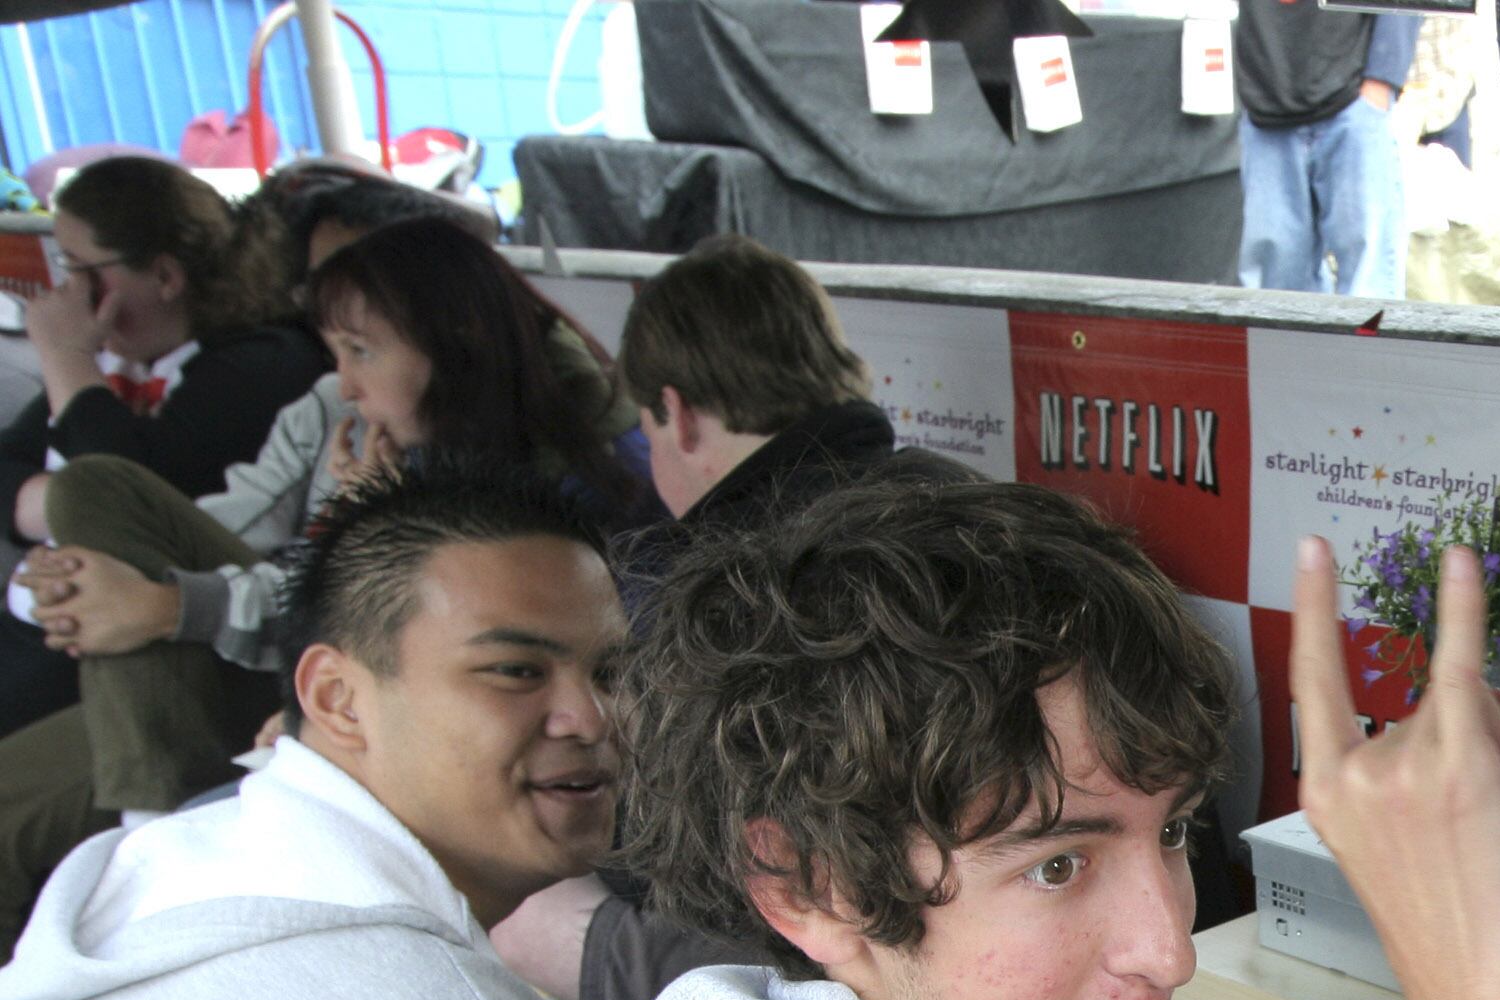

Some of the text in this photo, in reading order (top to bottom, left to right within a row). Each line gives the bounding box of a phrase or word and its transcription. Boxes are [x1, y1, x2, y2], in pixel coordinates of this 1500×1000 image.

[1039, 391, 1219, 495] NETFLIX
[1265, 452, 1369, 485] starlight
[1317, 486, 1393, 511] children's
